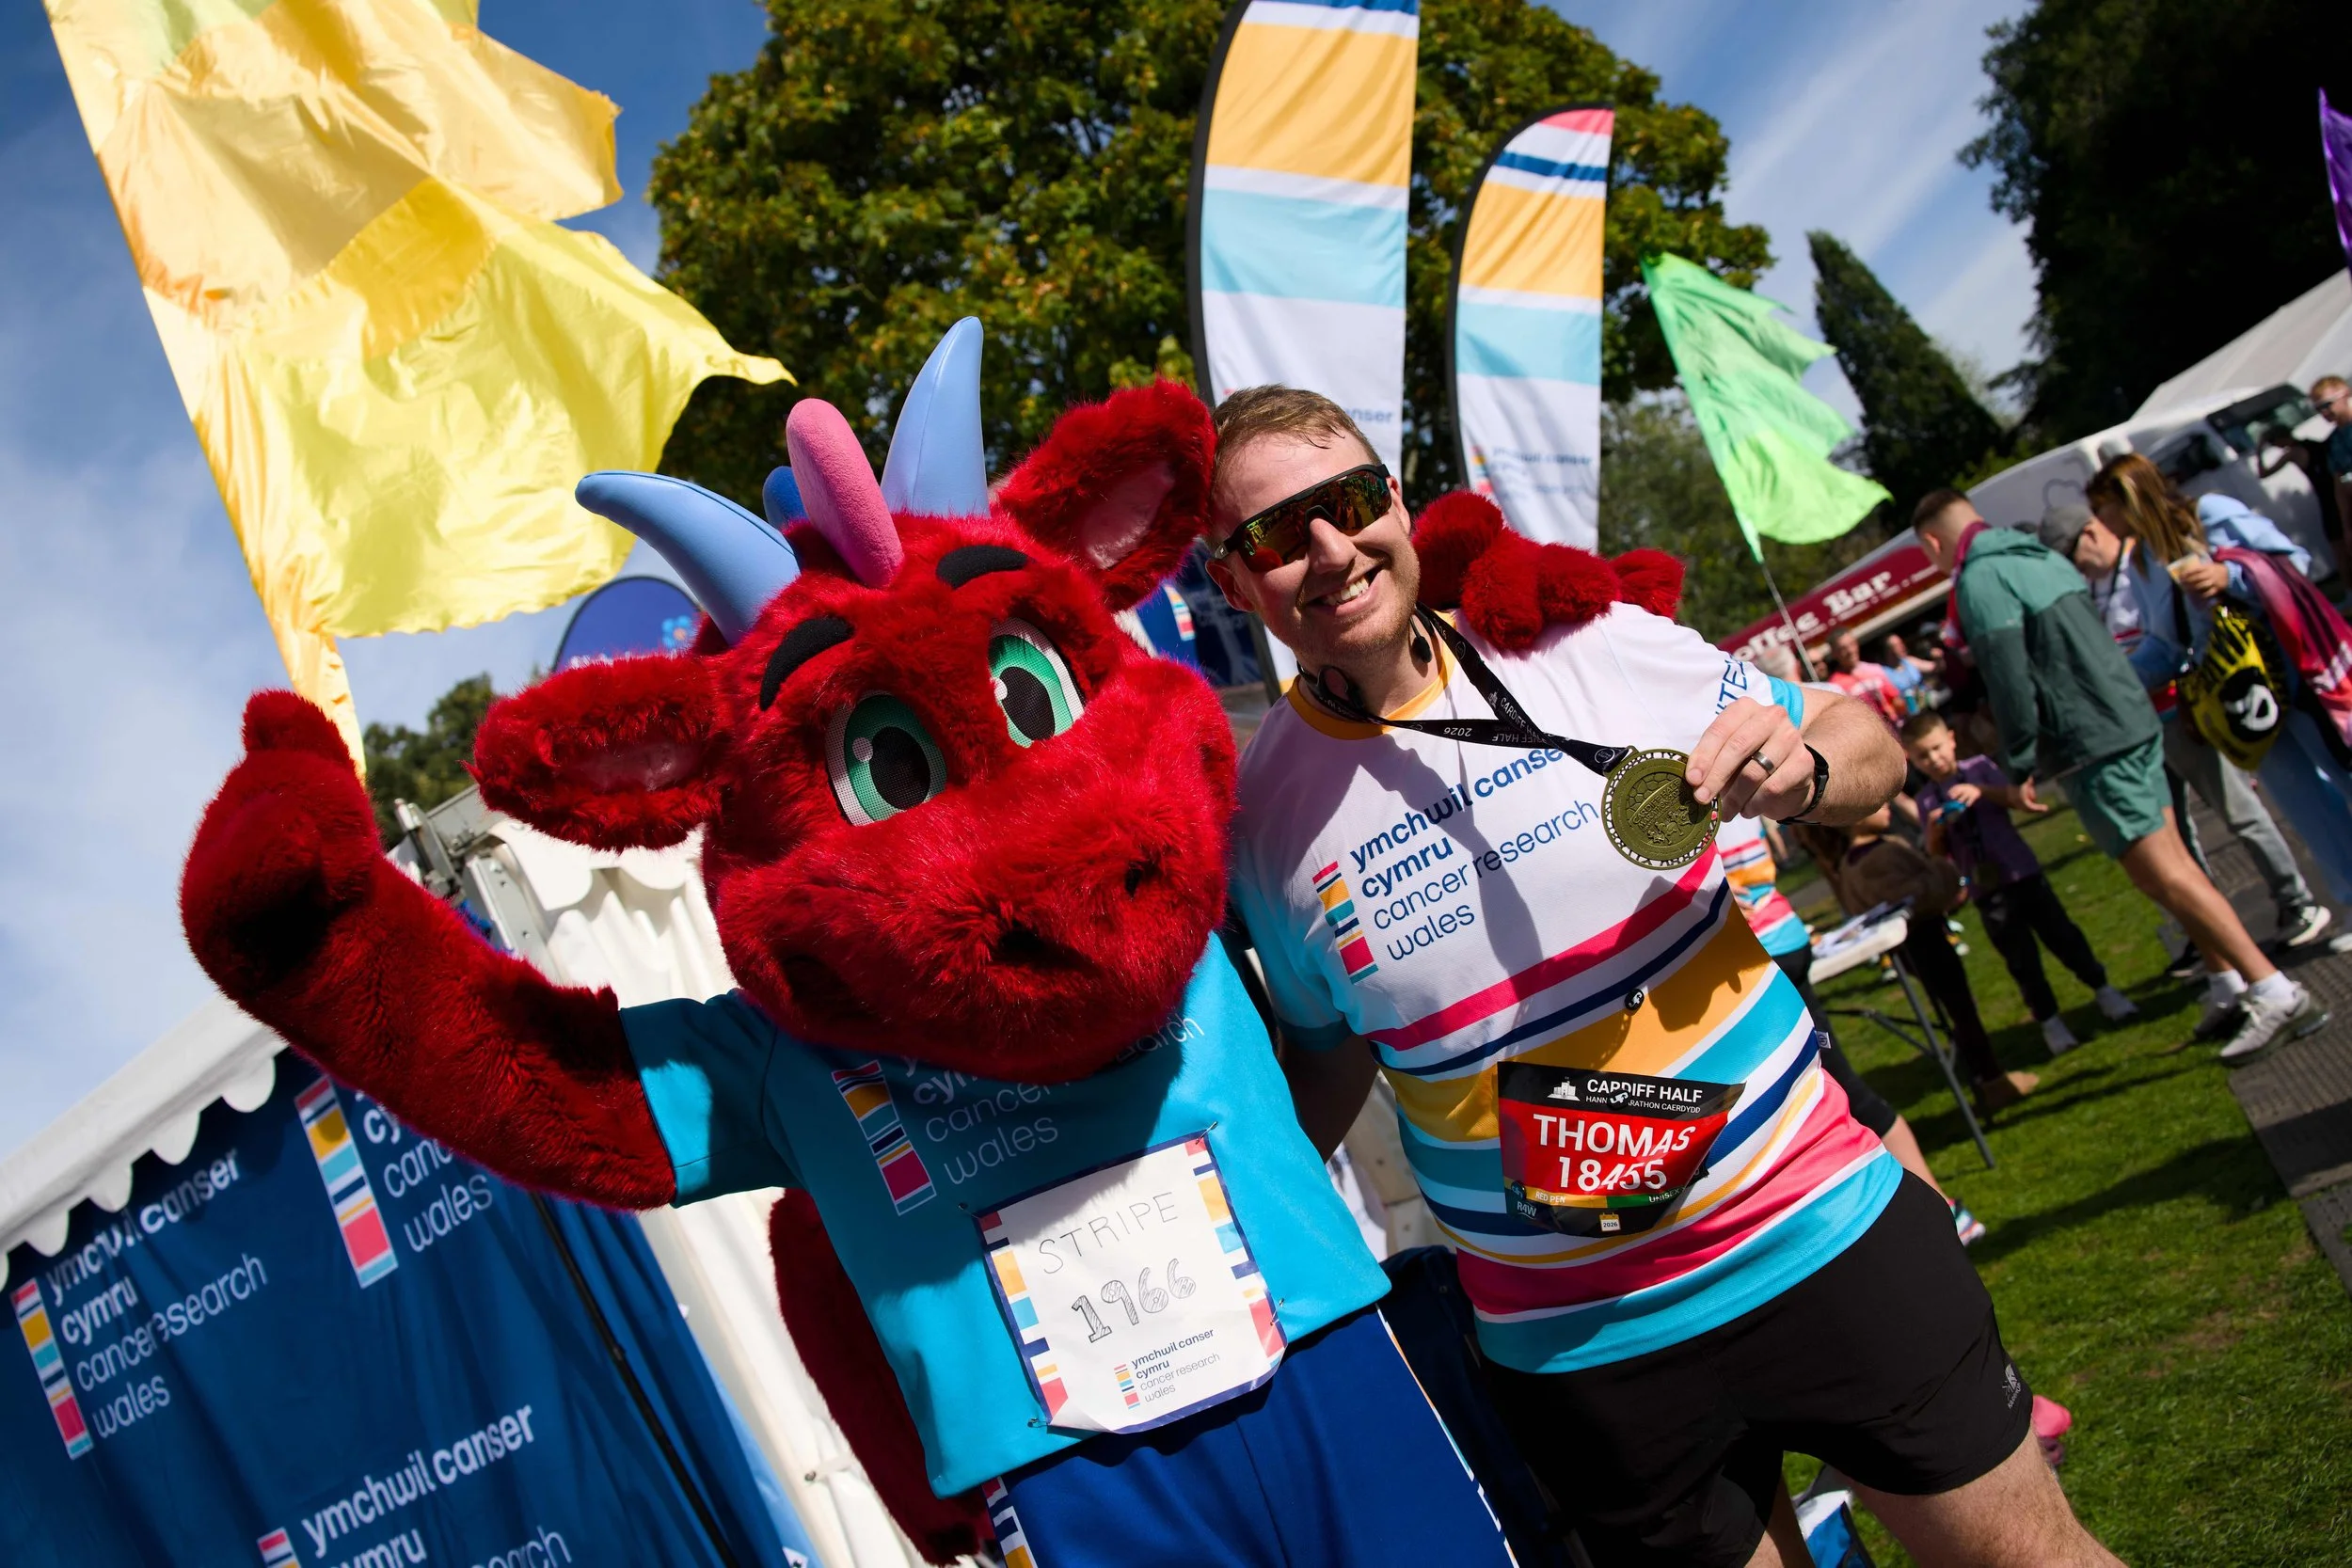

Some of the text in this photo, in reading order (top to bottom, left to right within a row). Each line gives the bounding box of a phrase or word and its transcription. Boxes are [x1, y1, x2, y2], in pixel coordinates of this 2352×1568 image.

[1822, 570, 1892, 614] Bar
[1443, 726, 1472, 737] 2026
[1349, 747, 1565, 875] ymchwil canse
[1360, 836, 1454, 898] cymru
[1374, 863, 1469, 929] cancer
[1471, 800, 1600, 879] research
[1386, 903, 1475, 961] wales
[1585, 1095, 1609, 1105] HANN
[1661, 1102, 1701, 1114] CAERDYDD
[1659, 1085, 1704, 1103] HALF
[943, 1116, 1058, 1185] wales
[1532, 1113, 1696, 1157] THOMAS
[139, 1148, 241, 1234] canser
[1558, 1156, 1668, 1193] 18455
[404, 1174, 493, 1253] wales
[1517, 1200, 1537, 1217] R4W
[1534, 1191, 1566, 1204] RED PEN
[1039, 1191, 1179, 1275] STRIPE
[1602, 1220, 1618, 1228] 2026
[60, 1275, 139, 1346] cymru
[1071, 1258, 1197, 1344] 1966
[1131, 1328, 1215, 1370] ymchwil canser
[1136, 1360, 1170, 1380] cymru
[1139, 1352, 1220, 1391] cancer research
[1144, 1384, 1176, 1402] wales
[91, 1374, 171, 1439] wales
[301, 1403, 535, 1559] ymchwil canser
